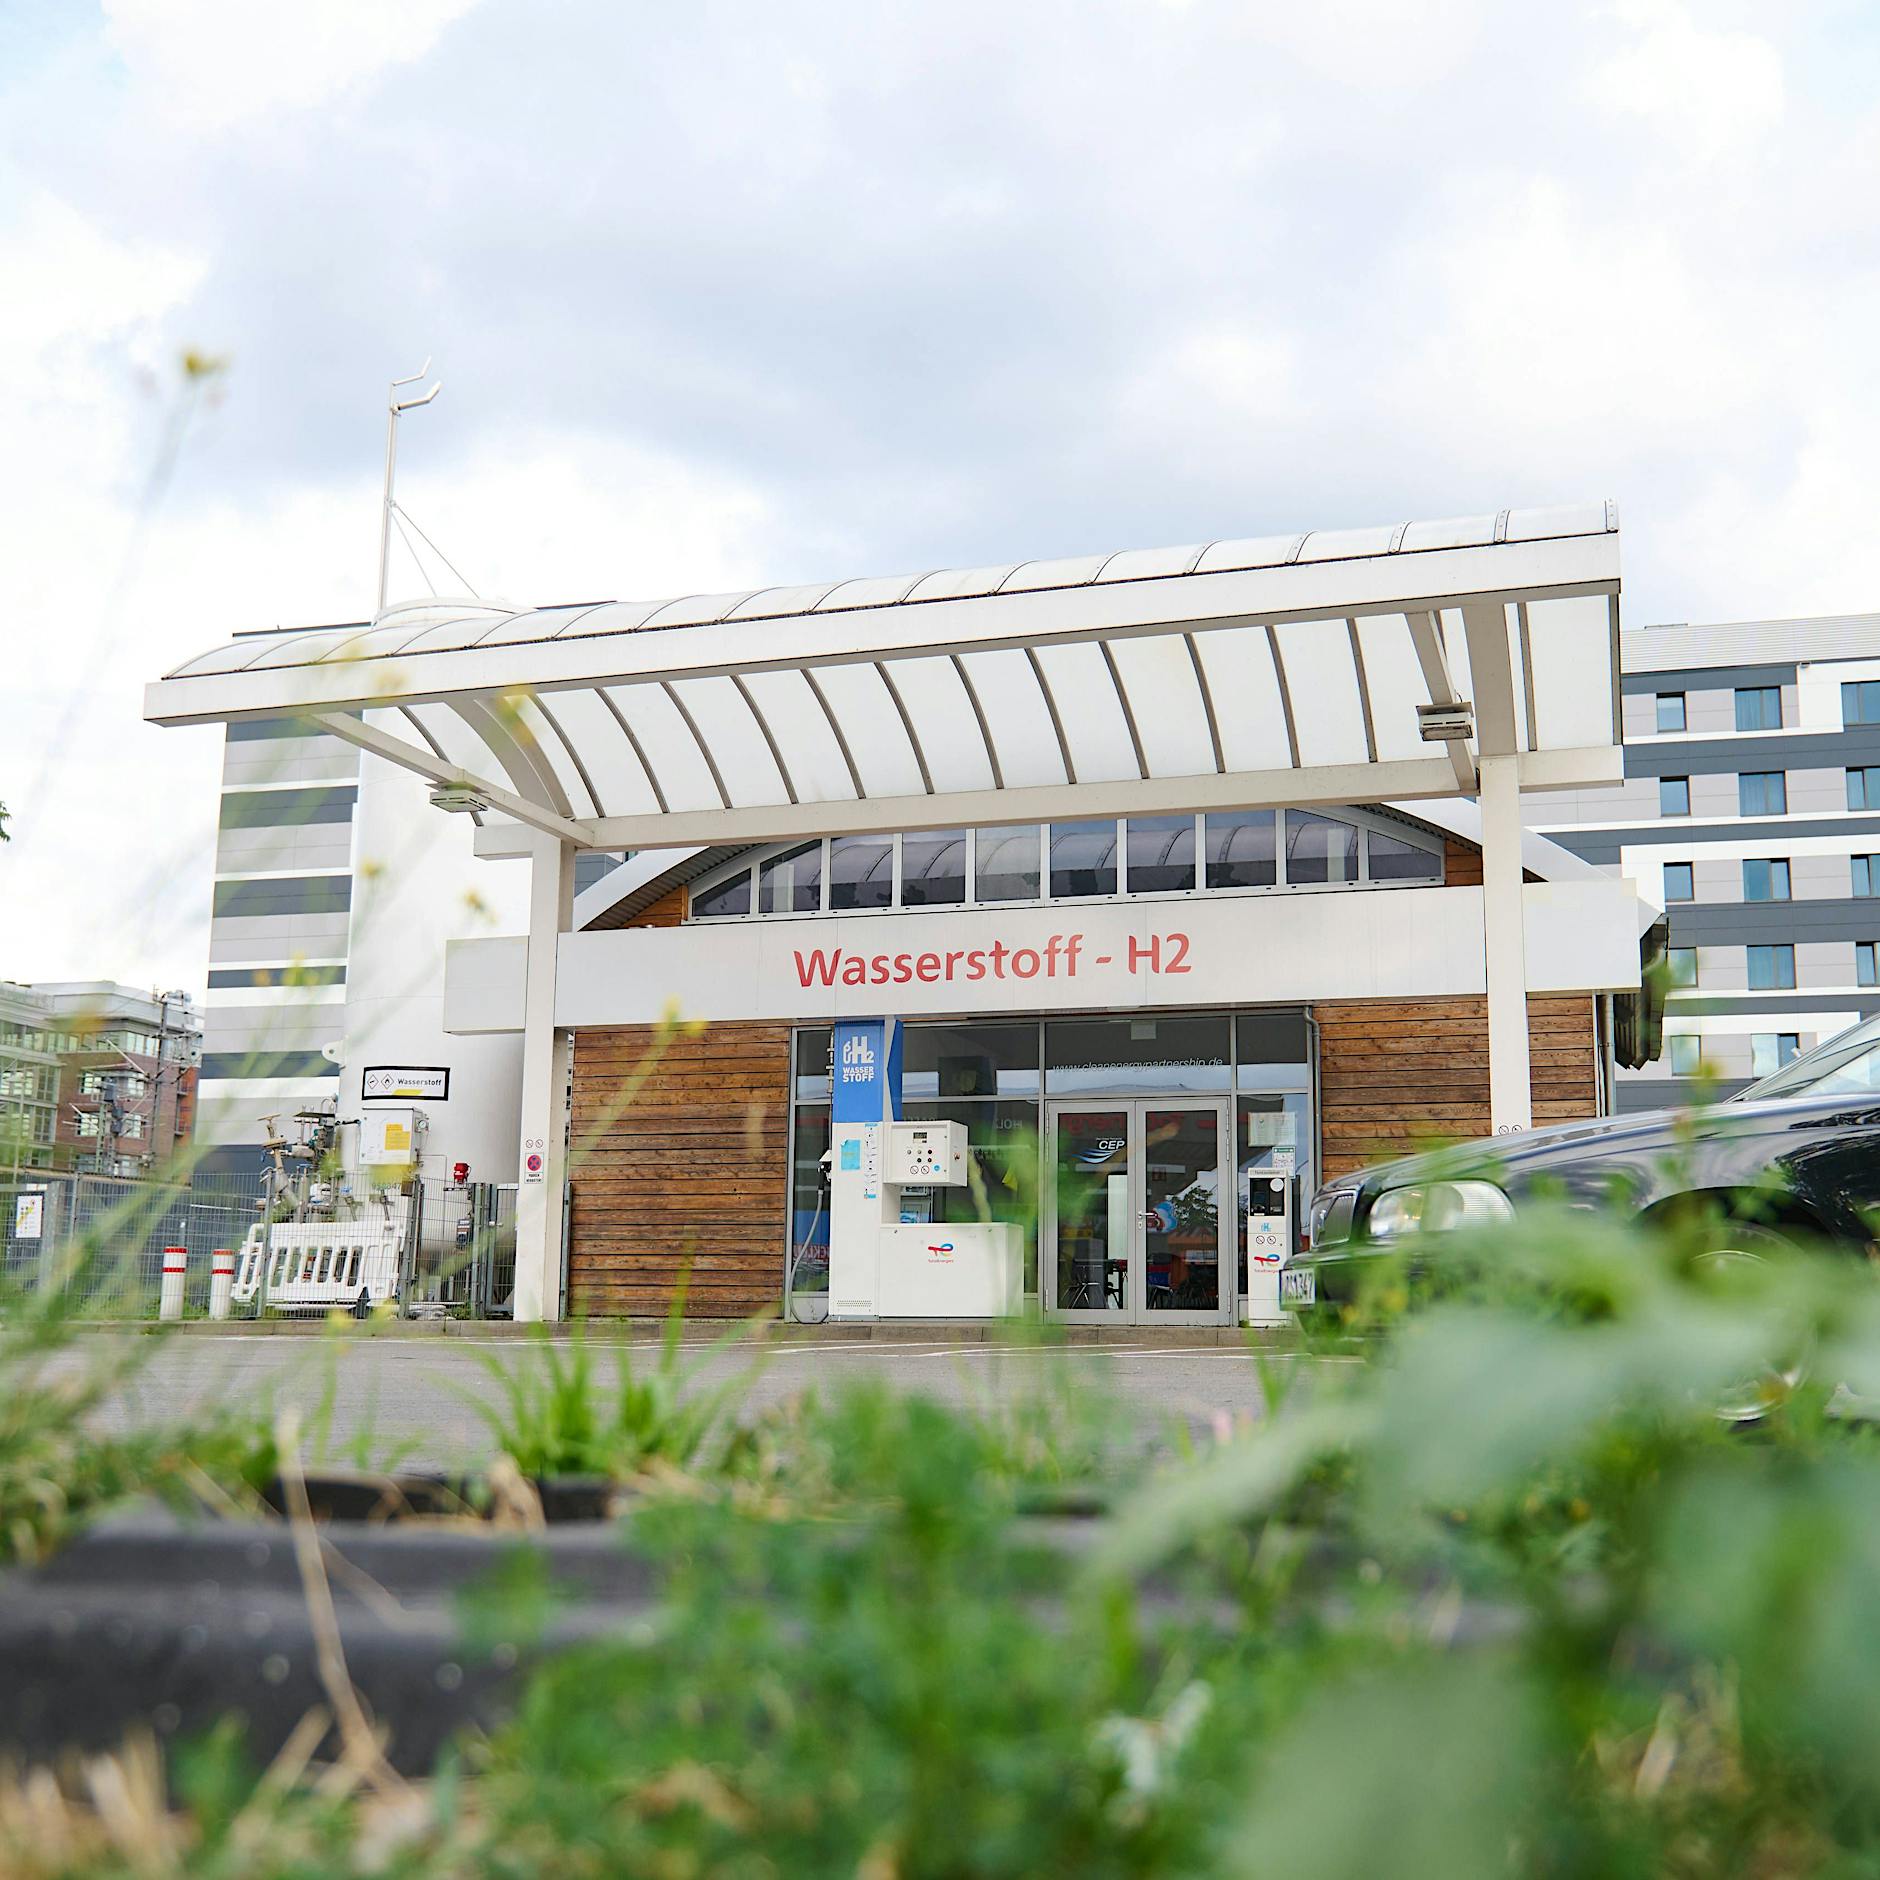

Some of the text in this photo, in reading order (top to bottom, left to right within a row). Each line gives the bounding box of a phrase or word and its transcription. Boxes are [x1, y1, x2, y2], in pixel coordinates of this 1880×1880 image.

[794, 932, 1193, 987] Wasserstoff - H2
[842, 1066, 875, 1074] WASSER
[1052, 1056, 1223, 1074] www.cleanenergypartnership.de
[397, 1078, 442, 1086] Wasserstoff
[842, 1073, 875, 1083] STOFF
[1098, 1140, 1125, 1150] CEP
